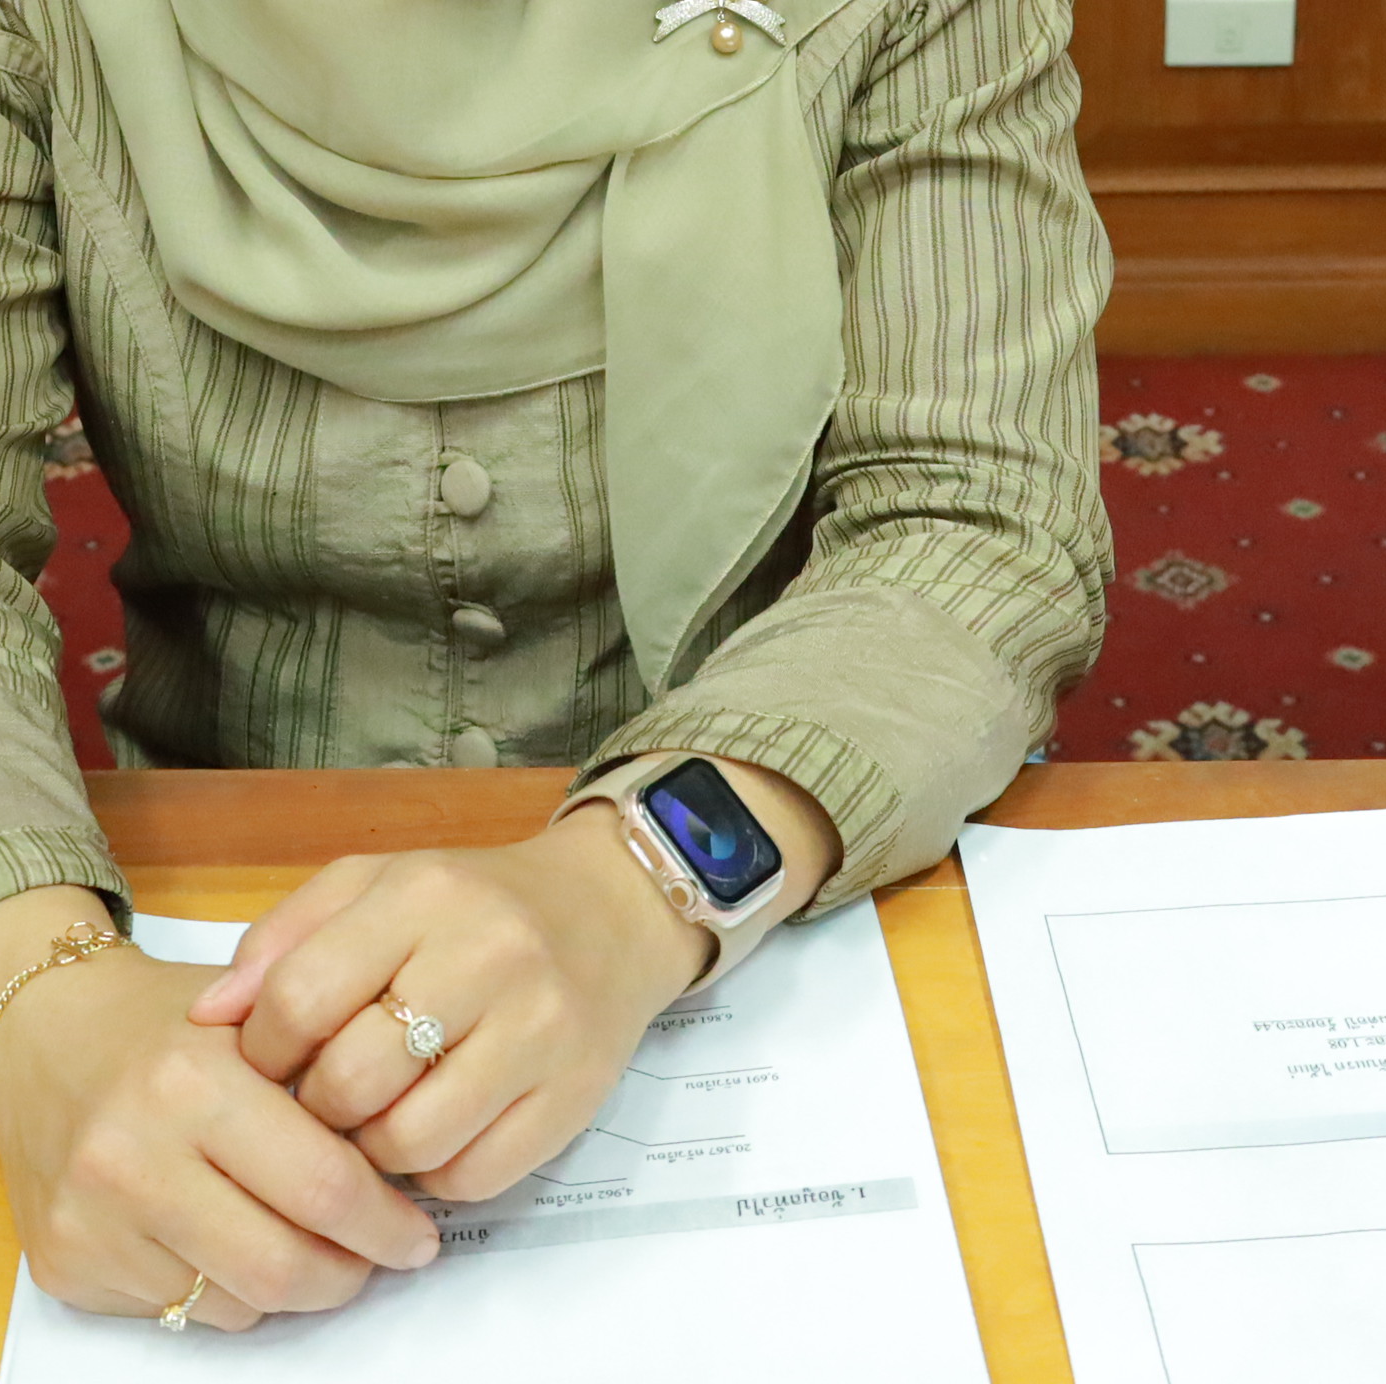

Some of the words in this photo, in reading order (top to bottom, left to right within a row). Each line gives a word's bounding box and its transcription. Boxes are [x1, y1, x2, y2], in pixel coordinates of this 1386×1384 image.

[701, 1011, 732, 1024] 6,861
[685, 1077, 741, 1092] ครัวเรือน
[746, 1071, 779, 1084] 9,691
[646, 1148, 704, 1163] ครัวเรือน
[709, 1143, 751, 1156] 20,367
[535, 1192, 593, 1208] ครัวเรือน
[598, 1187, 634, 1200] 4,962
[736, 1186, 845, 1219] ข้อมูลทั่วไป
[440, 1228, 490, 1245] จำนว
